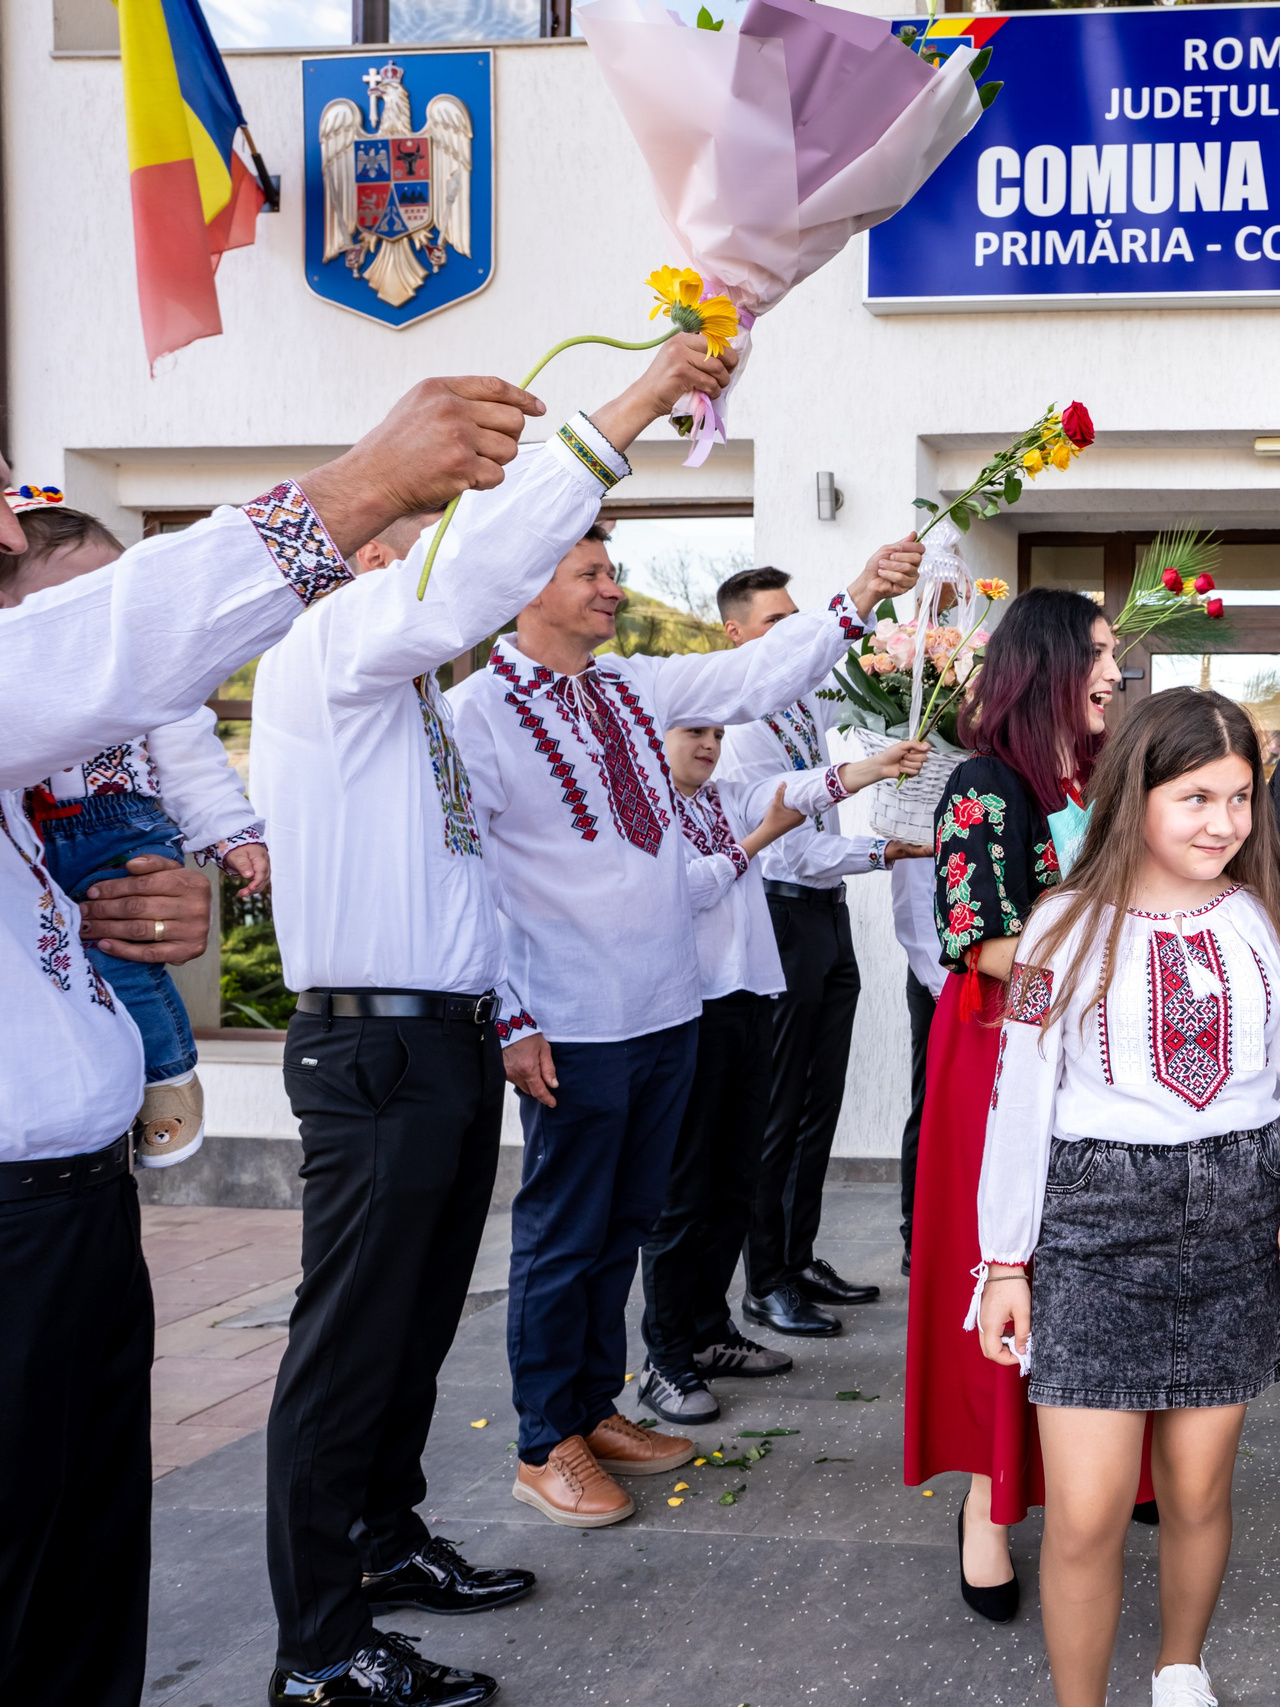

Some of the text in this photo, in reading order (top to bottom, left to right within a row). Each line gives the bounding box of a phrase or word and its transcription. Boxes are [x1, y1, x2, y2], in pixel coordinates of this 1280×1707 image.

[1104, 83, 1280, 126] JUDEȚUL
[976, 139, 1269, 219] COMUNA
[974, 218, 1195, 267] PRIMĂRIA
